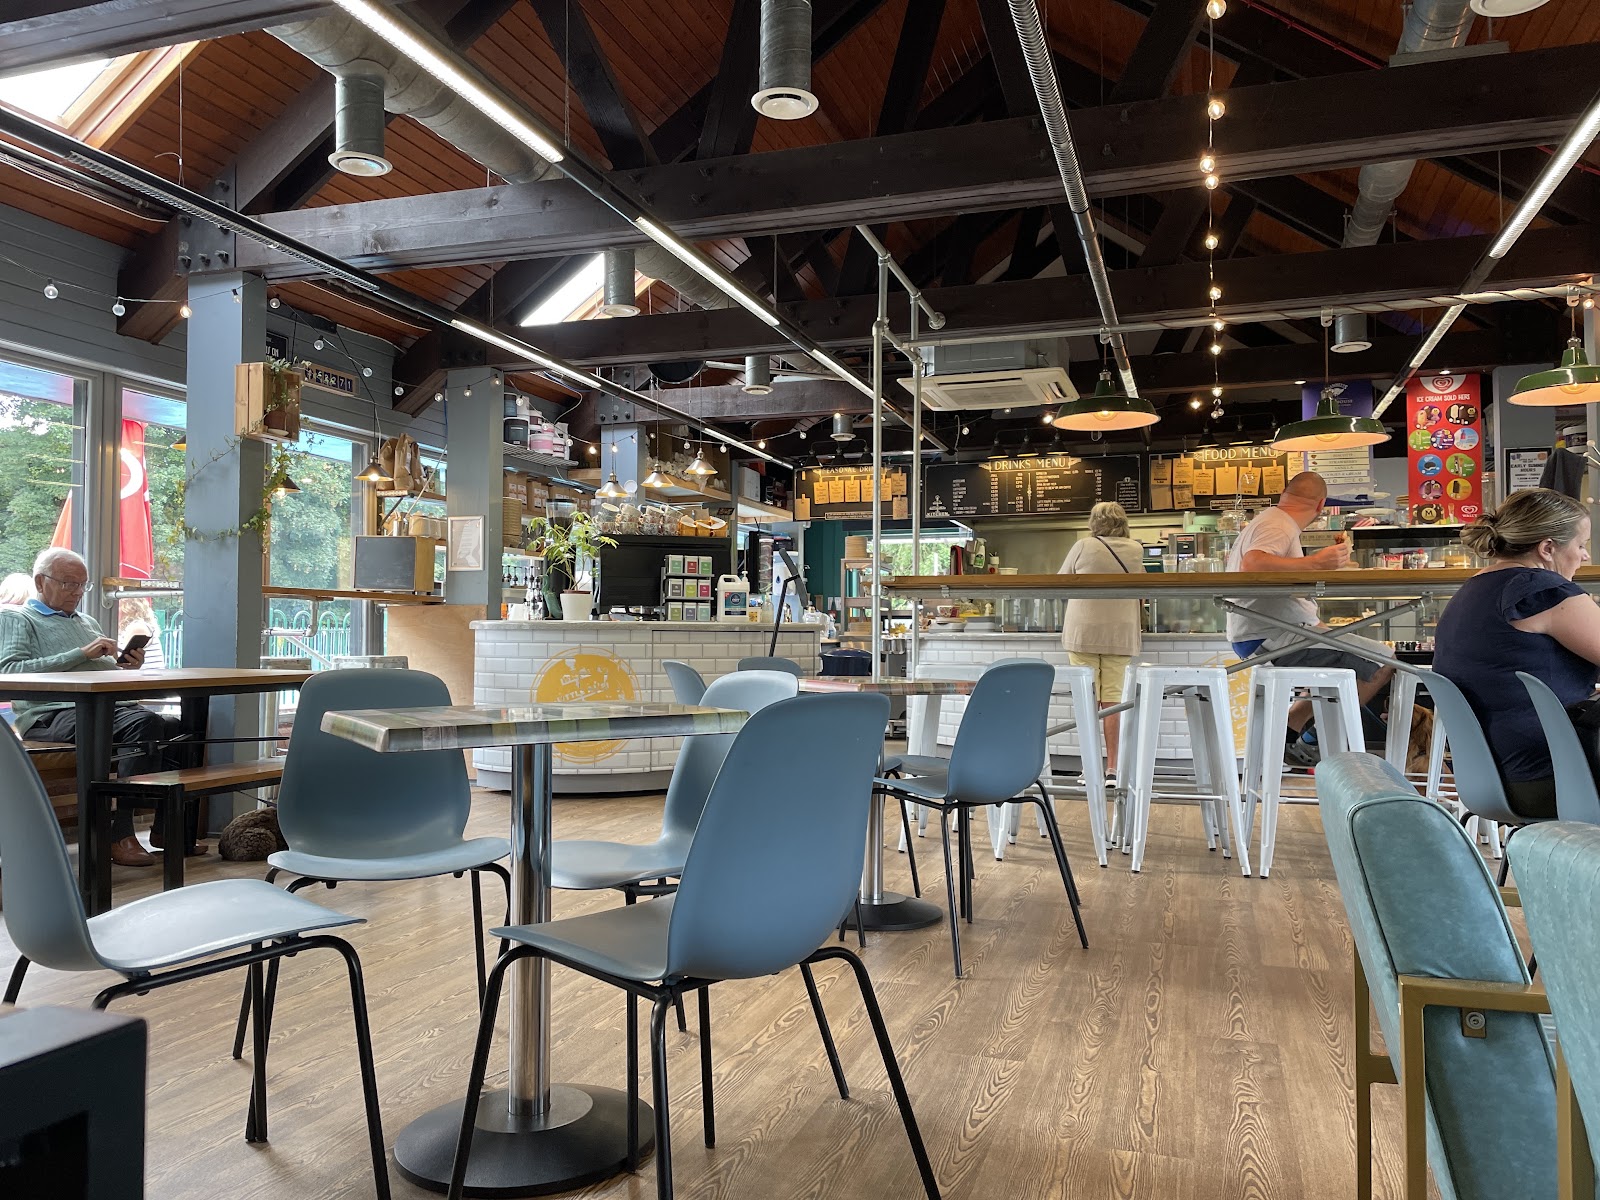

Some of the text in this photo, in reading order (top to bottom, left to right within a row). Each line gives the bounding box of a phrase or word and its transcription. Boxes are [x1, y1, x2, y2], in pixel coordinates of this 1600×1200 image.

[1204, 446, 1277, 460] FOOD MENU
[823, 466, 857, 475] SEASONAL
[994, 457, 1067, 471] DRINKS MENU
